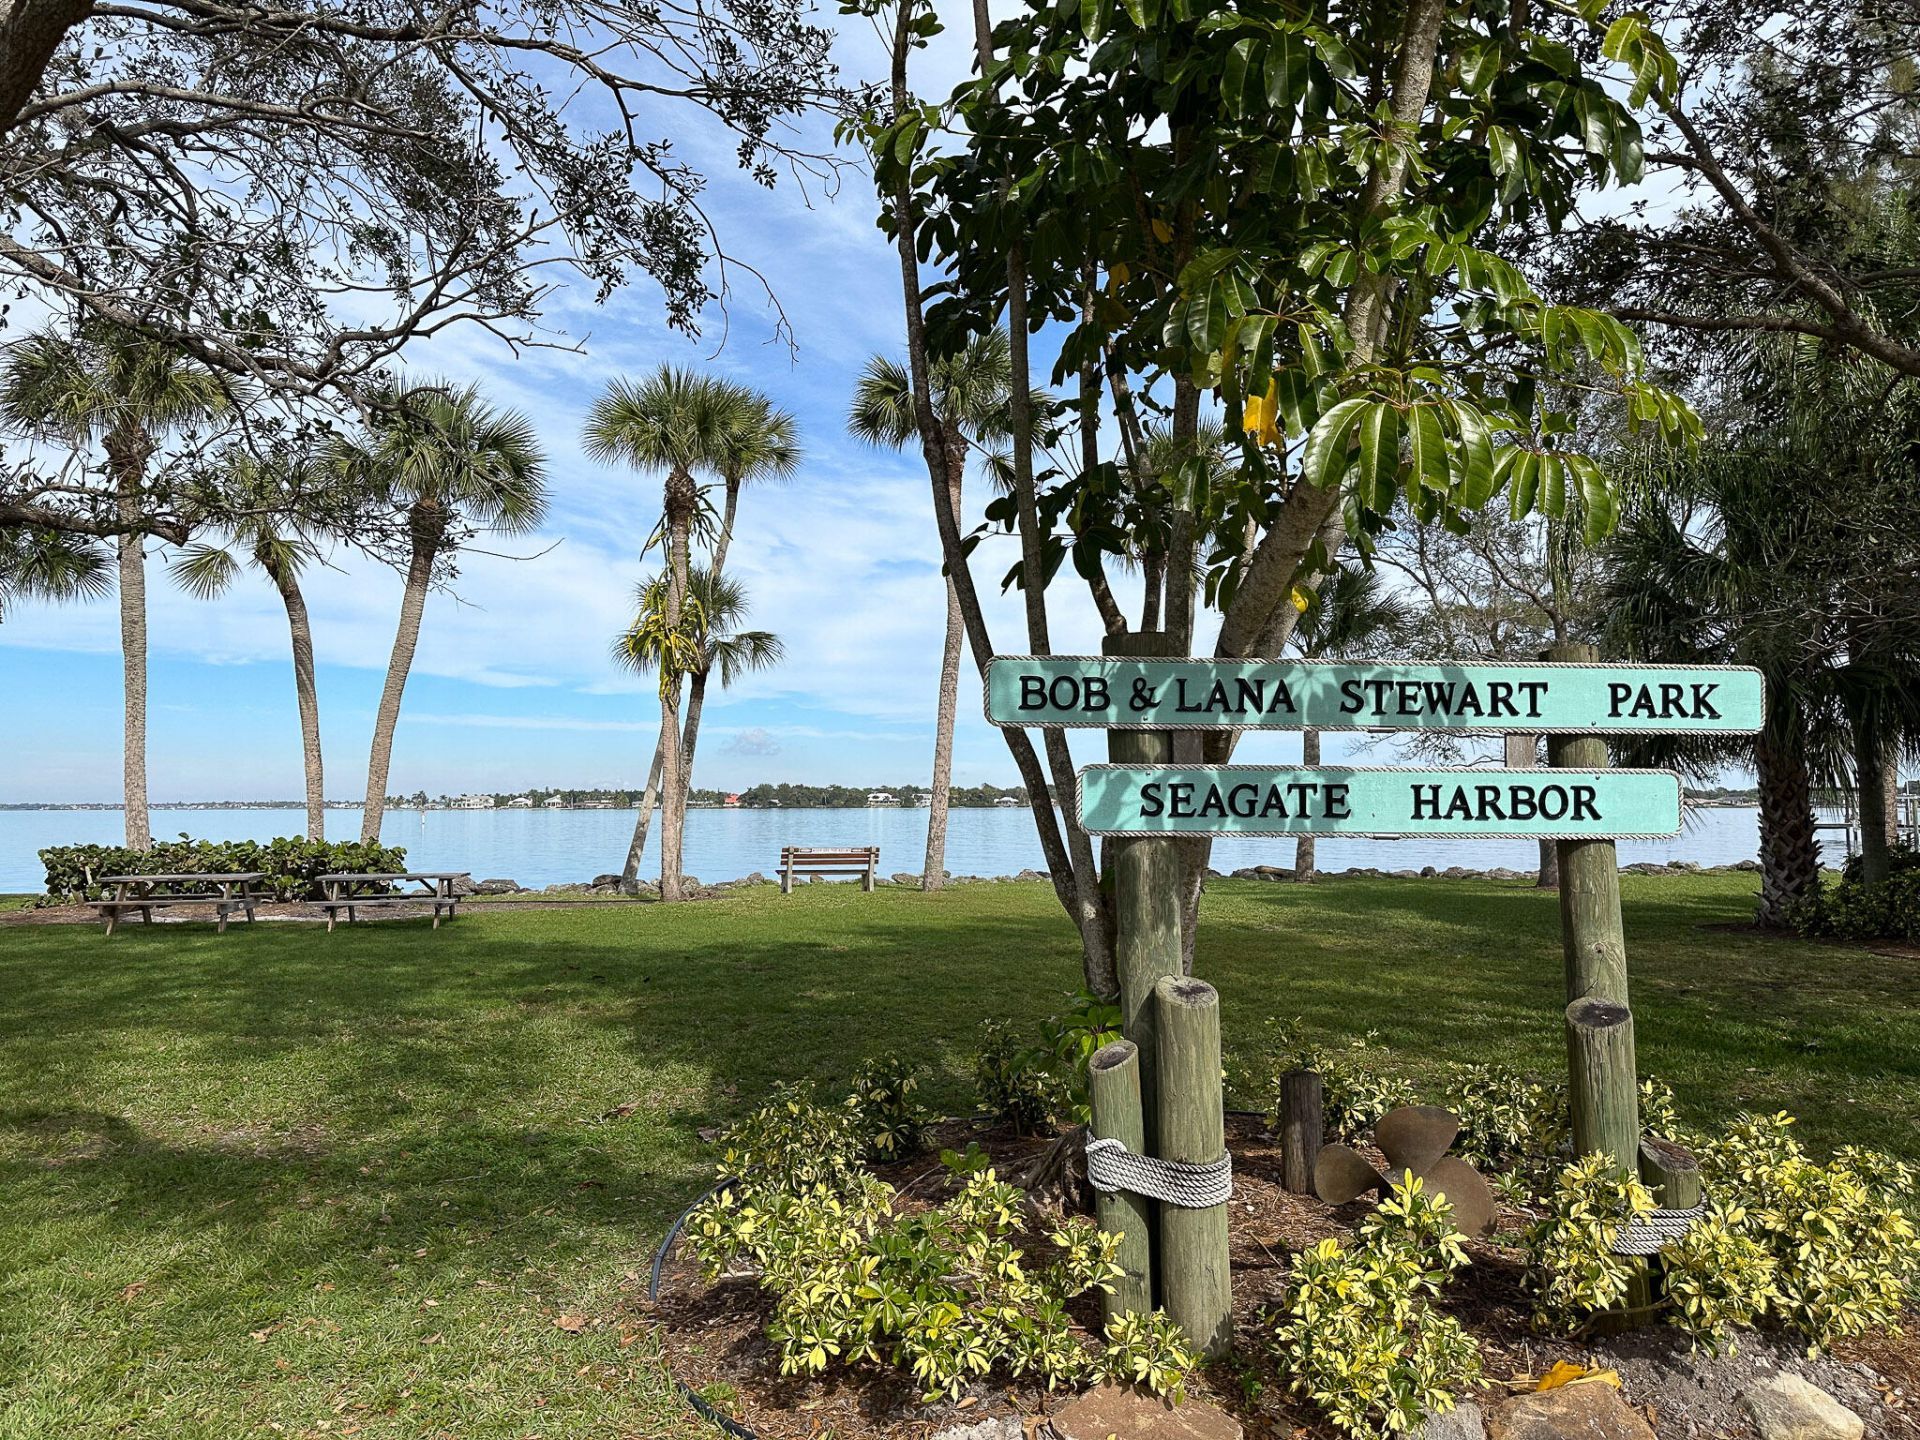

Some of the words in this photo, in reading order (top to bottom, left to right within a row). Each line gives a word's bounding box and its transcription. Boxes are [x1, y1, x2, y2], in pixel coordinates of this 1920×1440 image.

[1018, 675, 1111, 712] BOB
[1128, 676, 1161, 713] &
[1175, 677, 1297, 714] LANA
[1339, 679, 1549, 718] STEWART
[1607, 683, 1721, 719] PARK
[1139, 782, 1351, 819] SEAGATE
[1410, 784, 1602, 821] HARBOR
